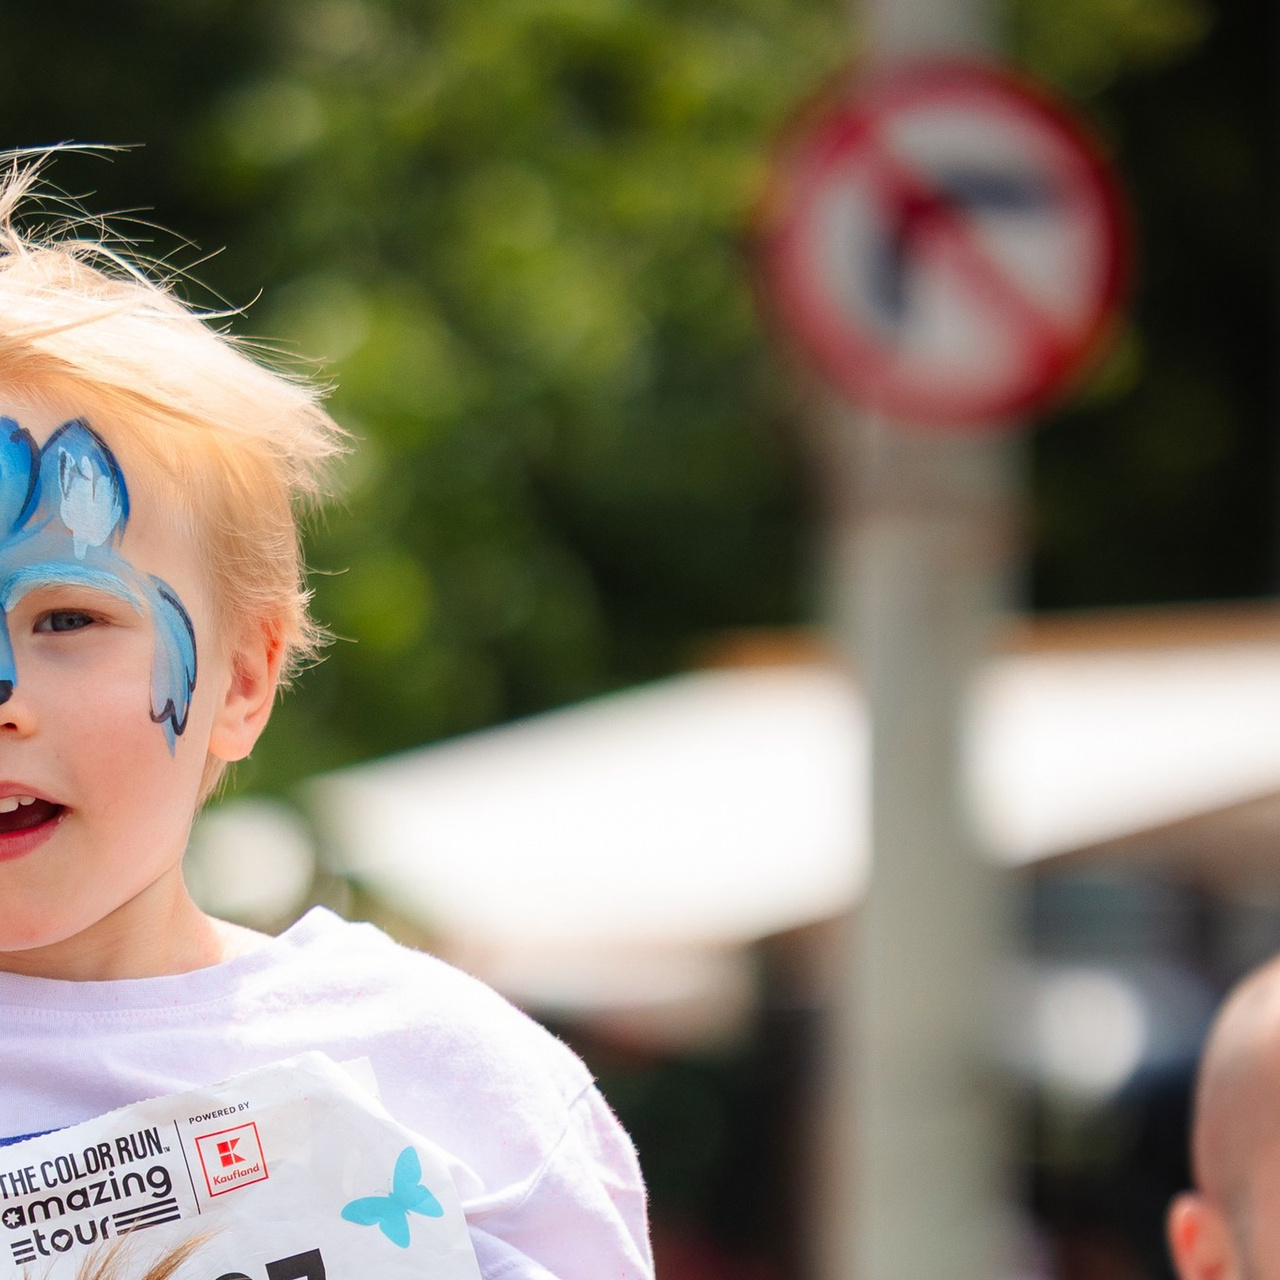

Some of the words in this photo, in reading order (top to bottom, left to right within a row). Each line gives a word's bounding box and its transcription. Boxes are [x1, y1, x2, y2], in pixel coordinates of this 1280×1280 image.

[188, 1106, 236, 1124] POWERED
[238, 1101, 250, 1111] BY
[40, 1142, 116, 1189] COLOR
[213, 1163, 260, 1185] Kaufland
[1, 1165, 173, 1230] amazing
[32, 1215, 110, 1257] tour
